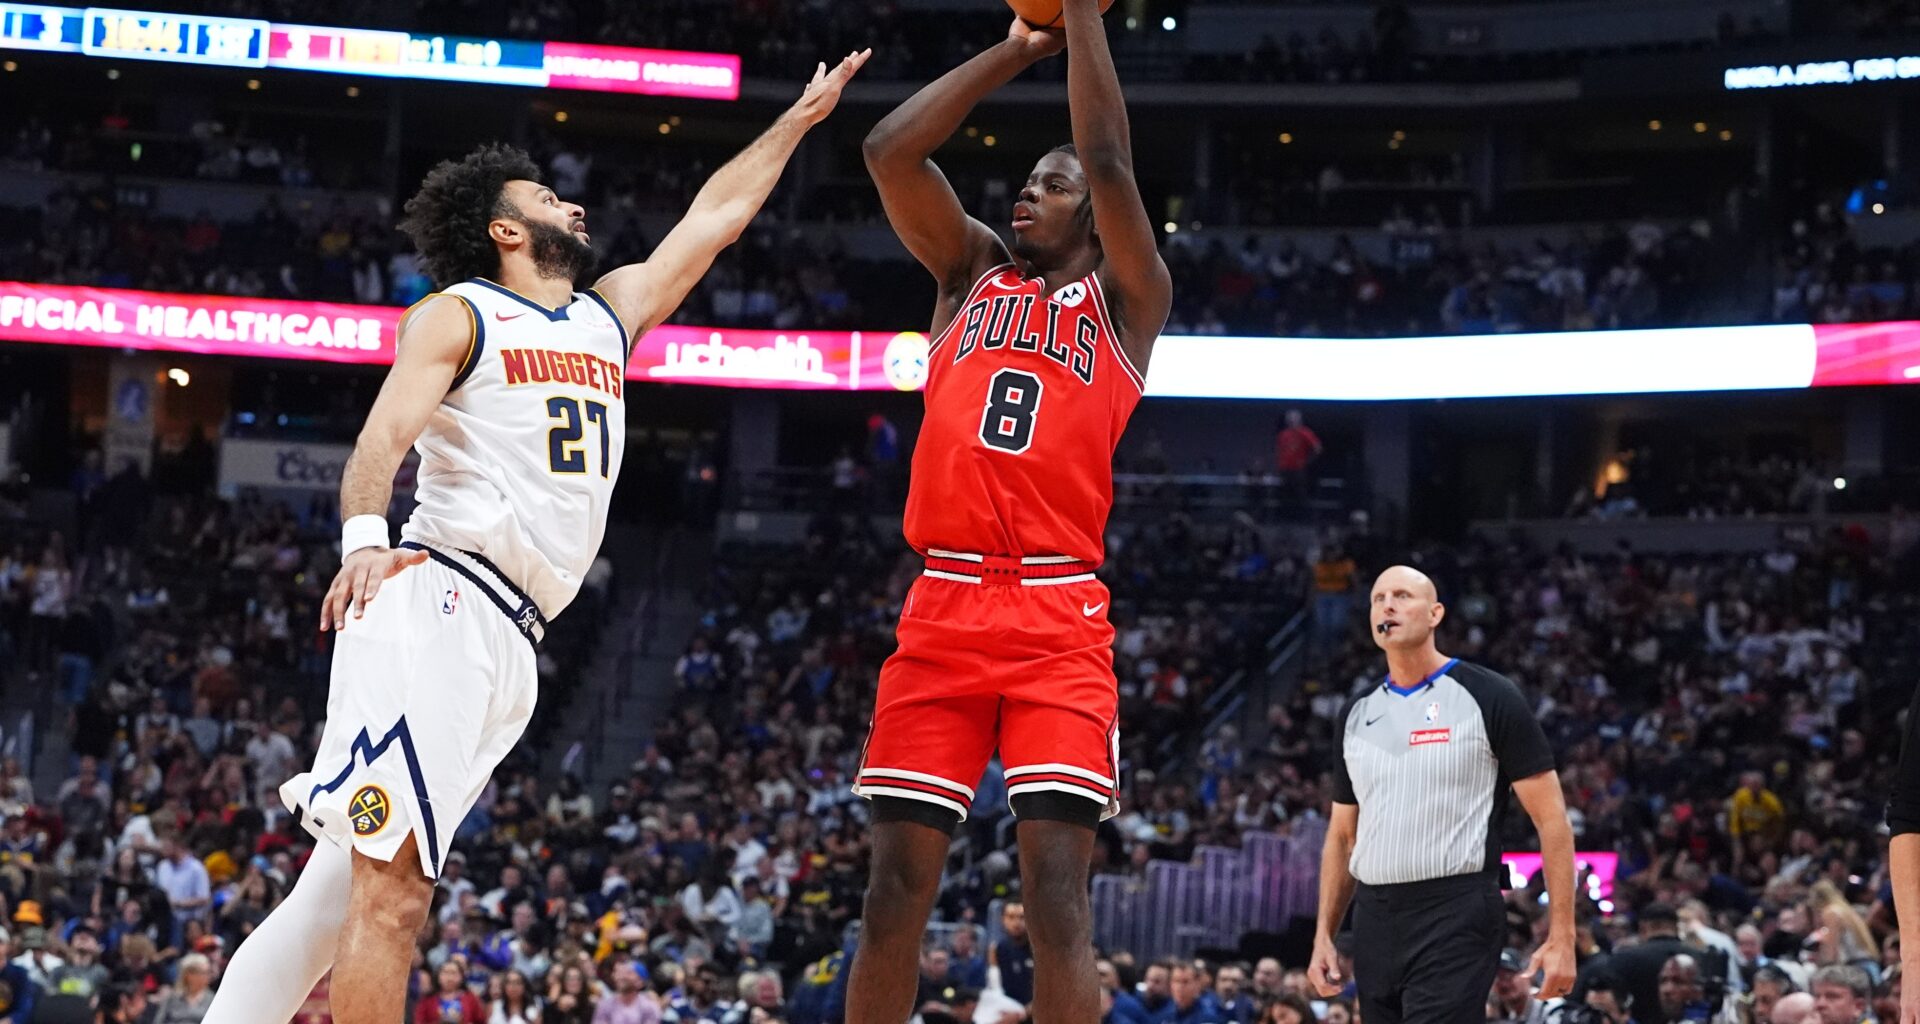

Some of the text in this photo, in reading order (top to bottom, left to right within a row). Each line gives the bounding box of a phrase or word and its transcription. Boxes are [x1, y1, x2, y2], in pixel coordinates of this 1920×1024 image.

[136, 304, 382, 350] HEALTHCARE
[665, 332, 823, 372] uchealth
[953, 294, 1099, 386] BULLS
[500, 348, 622, 400] NUGGETS
[545, 396, 610, 479] 27
[978, 367, 1044, 455] 8
